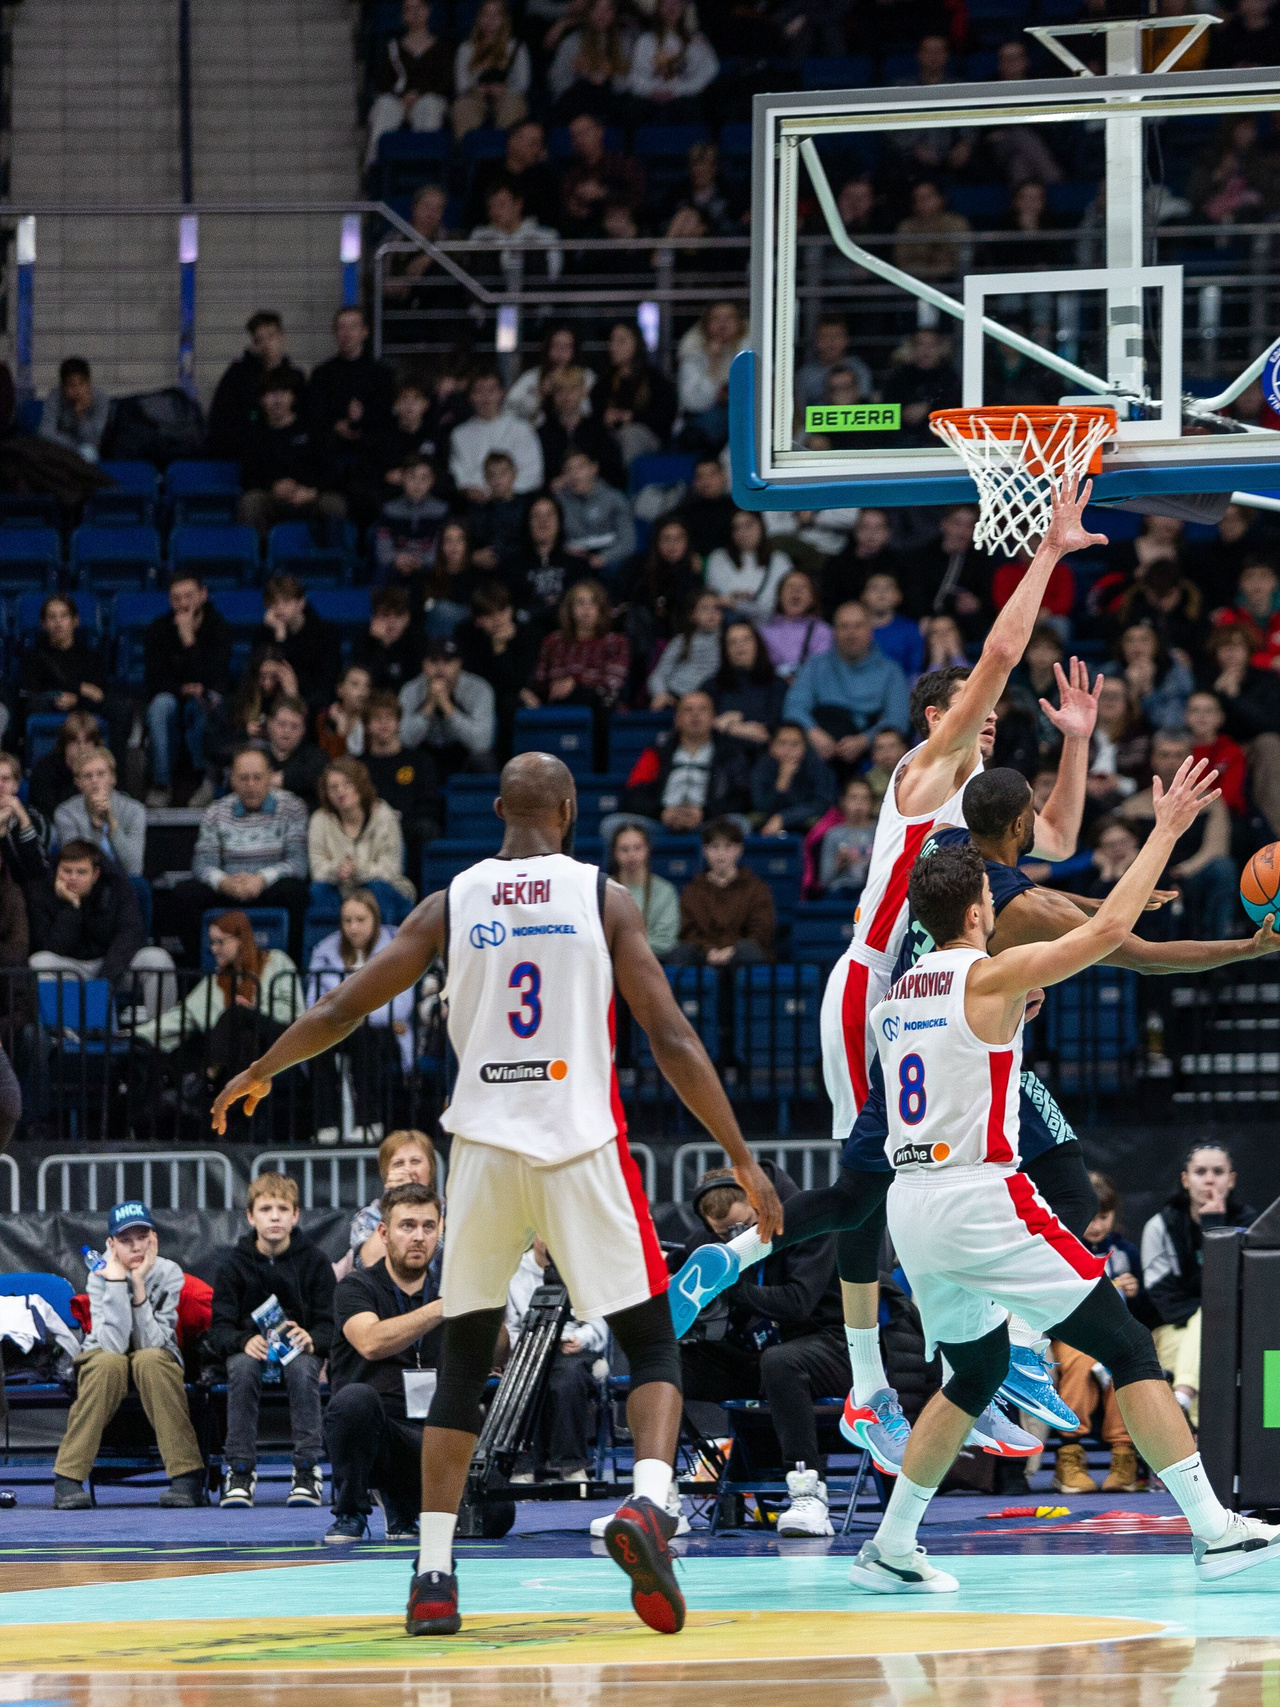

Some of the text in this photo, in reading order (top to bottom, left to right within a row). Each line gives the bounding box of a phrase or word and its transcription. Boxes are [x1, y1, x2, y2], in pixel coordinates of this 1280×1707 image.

[492, 879, 551, 906] JEKIRI
[511, 924, 577, 937] NORNICKEL
[507, 961, 543, 1039] 3
[903, 1017, 948, 1031] NORNICKEL
[485, 1065, 544, 1081] Winline
[898, 1052, 927, 1126] 8
